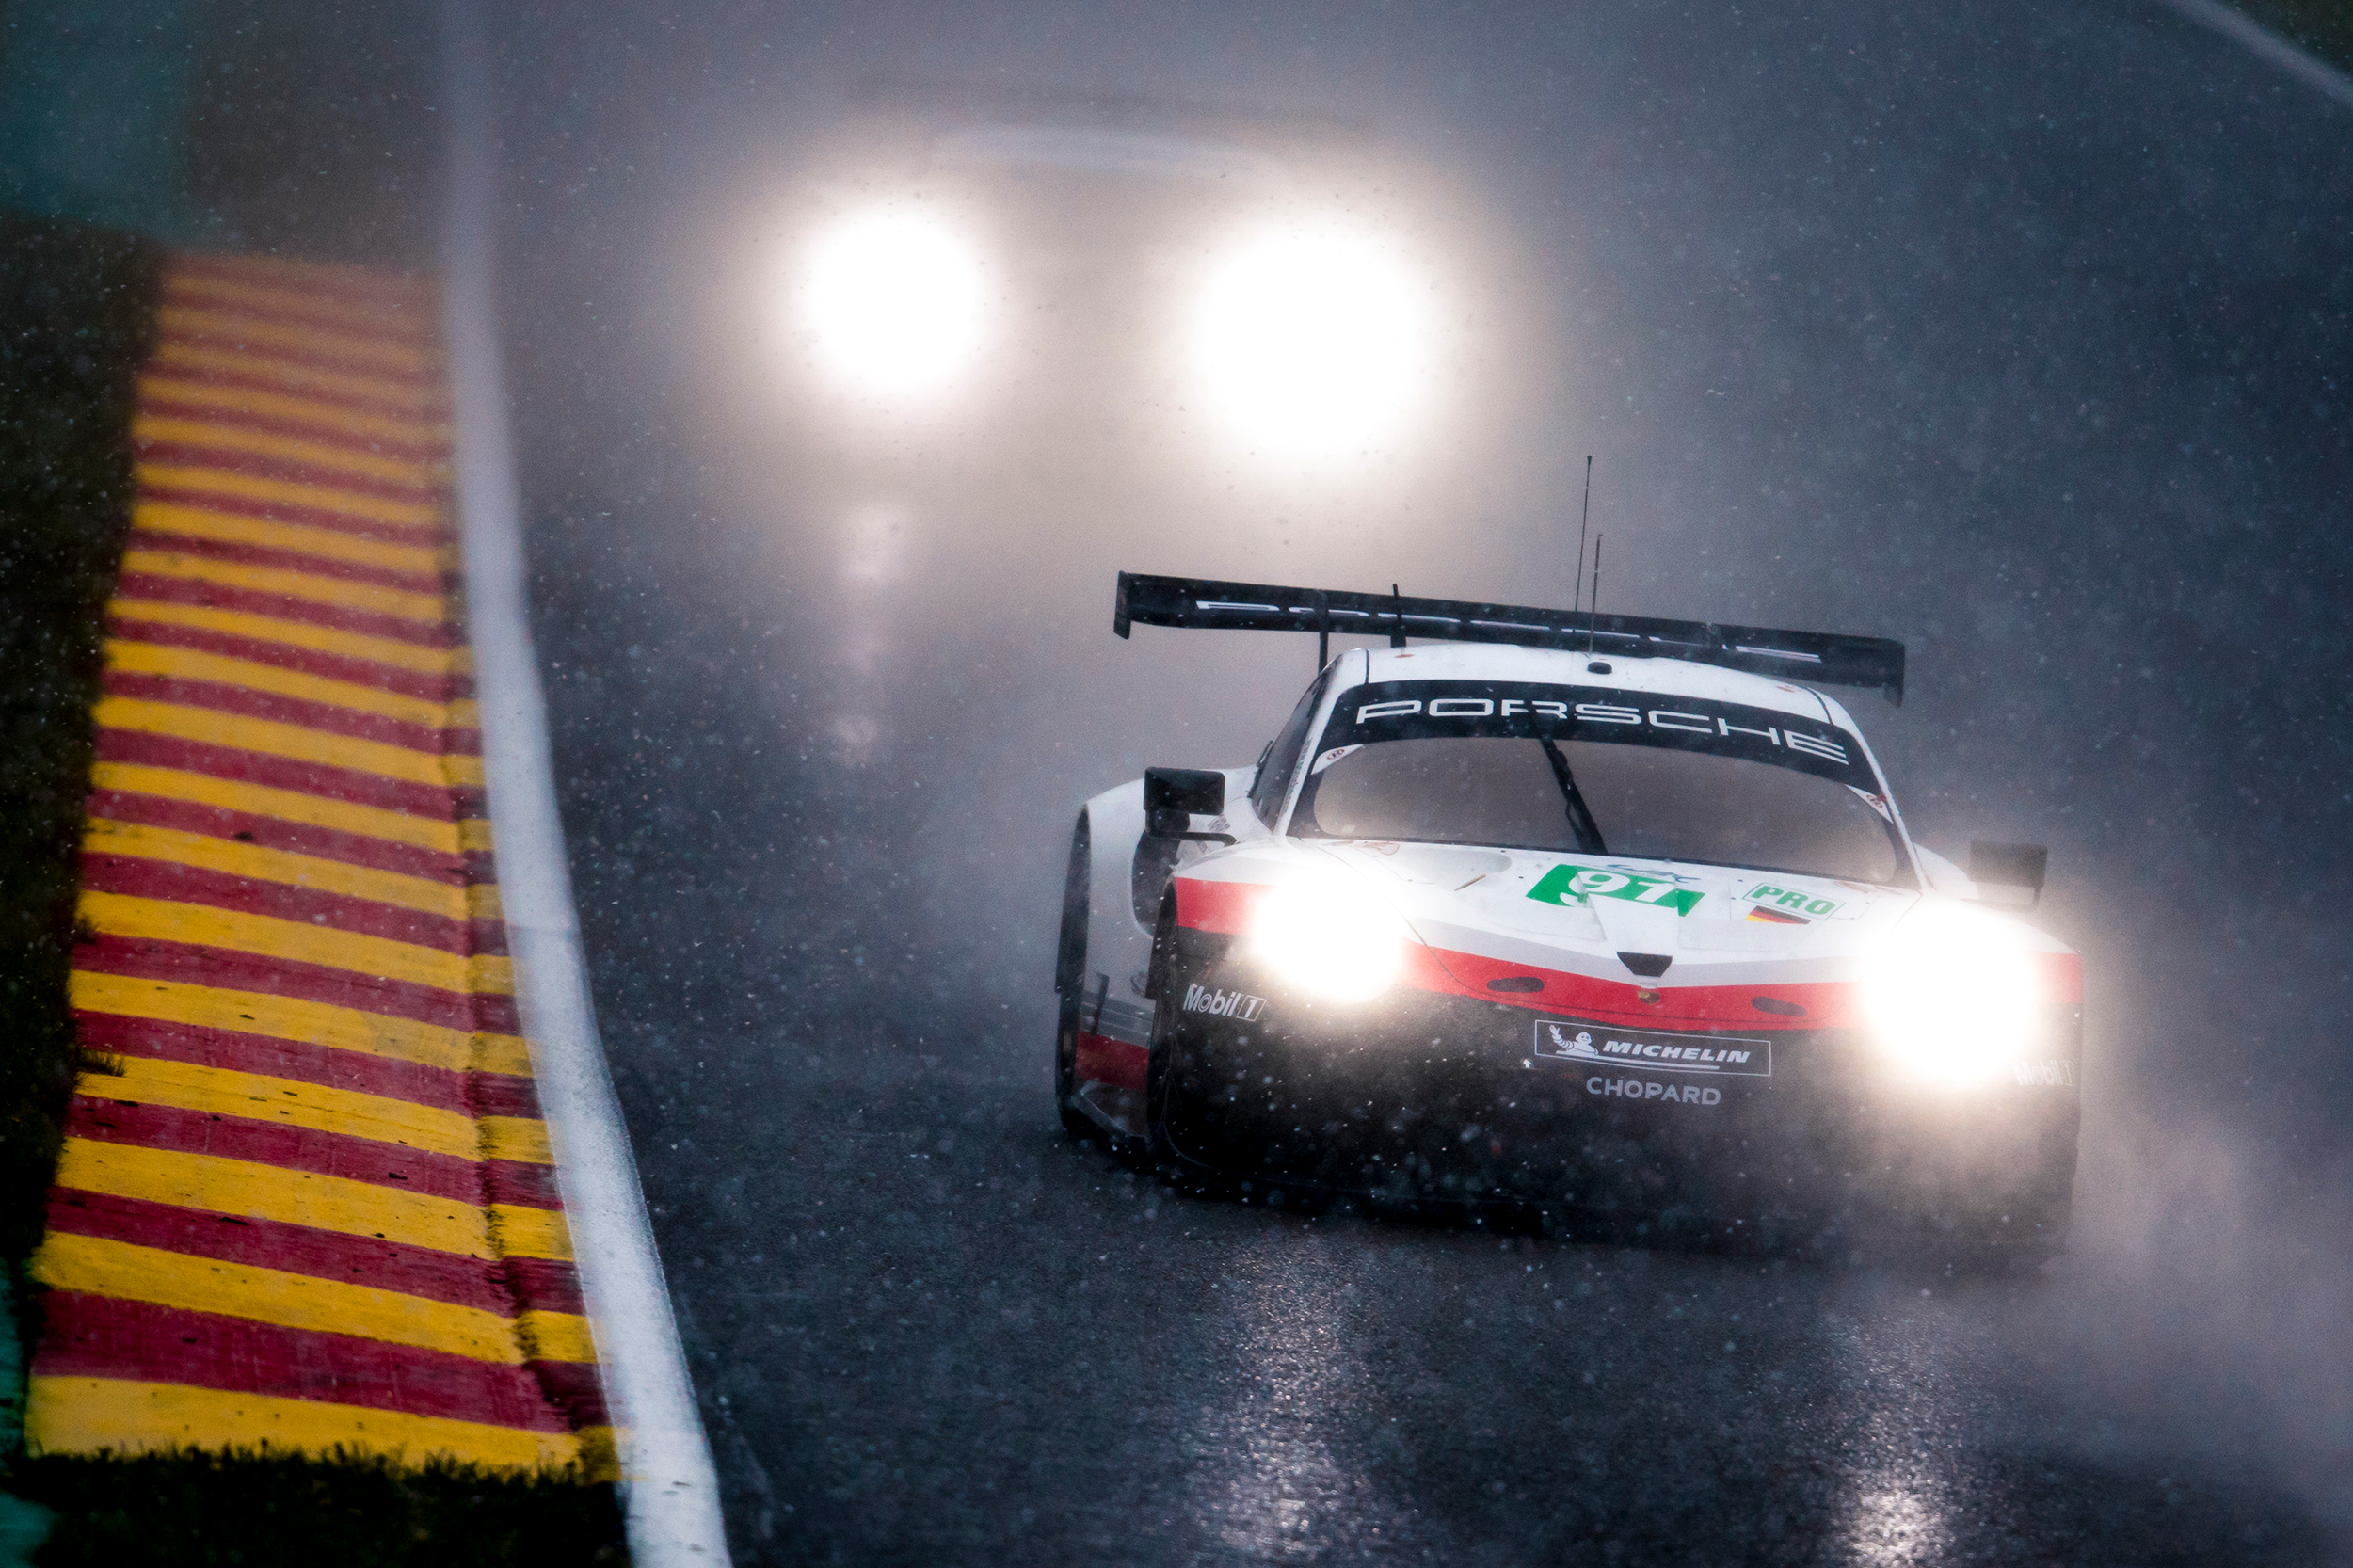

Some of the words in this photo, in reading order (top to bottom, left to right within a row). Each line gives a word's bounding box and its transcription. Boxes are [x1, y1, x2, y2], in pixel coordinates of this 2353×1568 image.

[1355, 698, 1849, 766] PORSCHE
[1558, 870, 1675, 907] 91
[1753, 885, 1836, 915] PRO
[1183, 984, 1241, 1017] Mobil
[1602, 1039, 1752, 1064] MICHELIN
[2011, 1060, 2063, 1086] Mobil
[1586, 1076, 1721, 1106] CHOPARD
